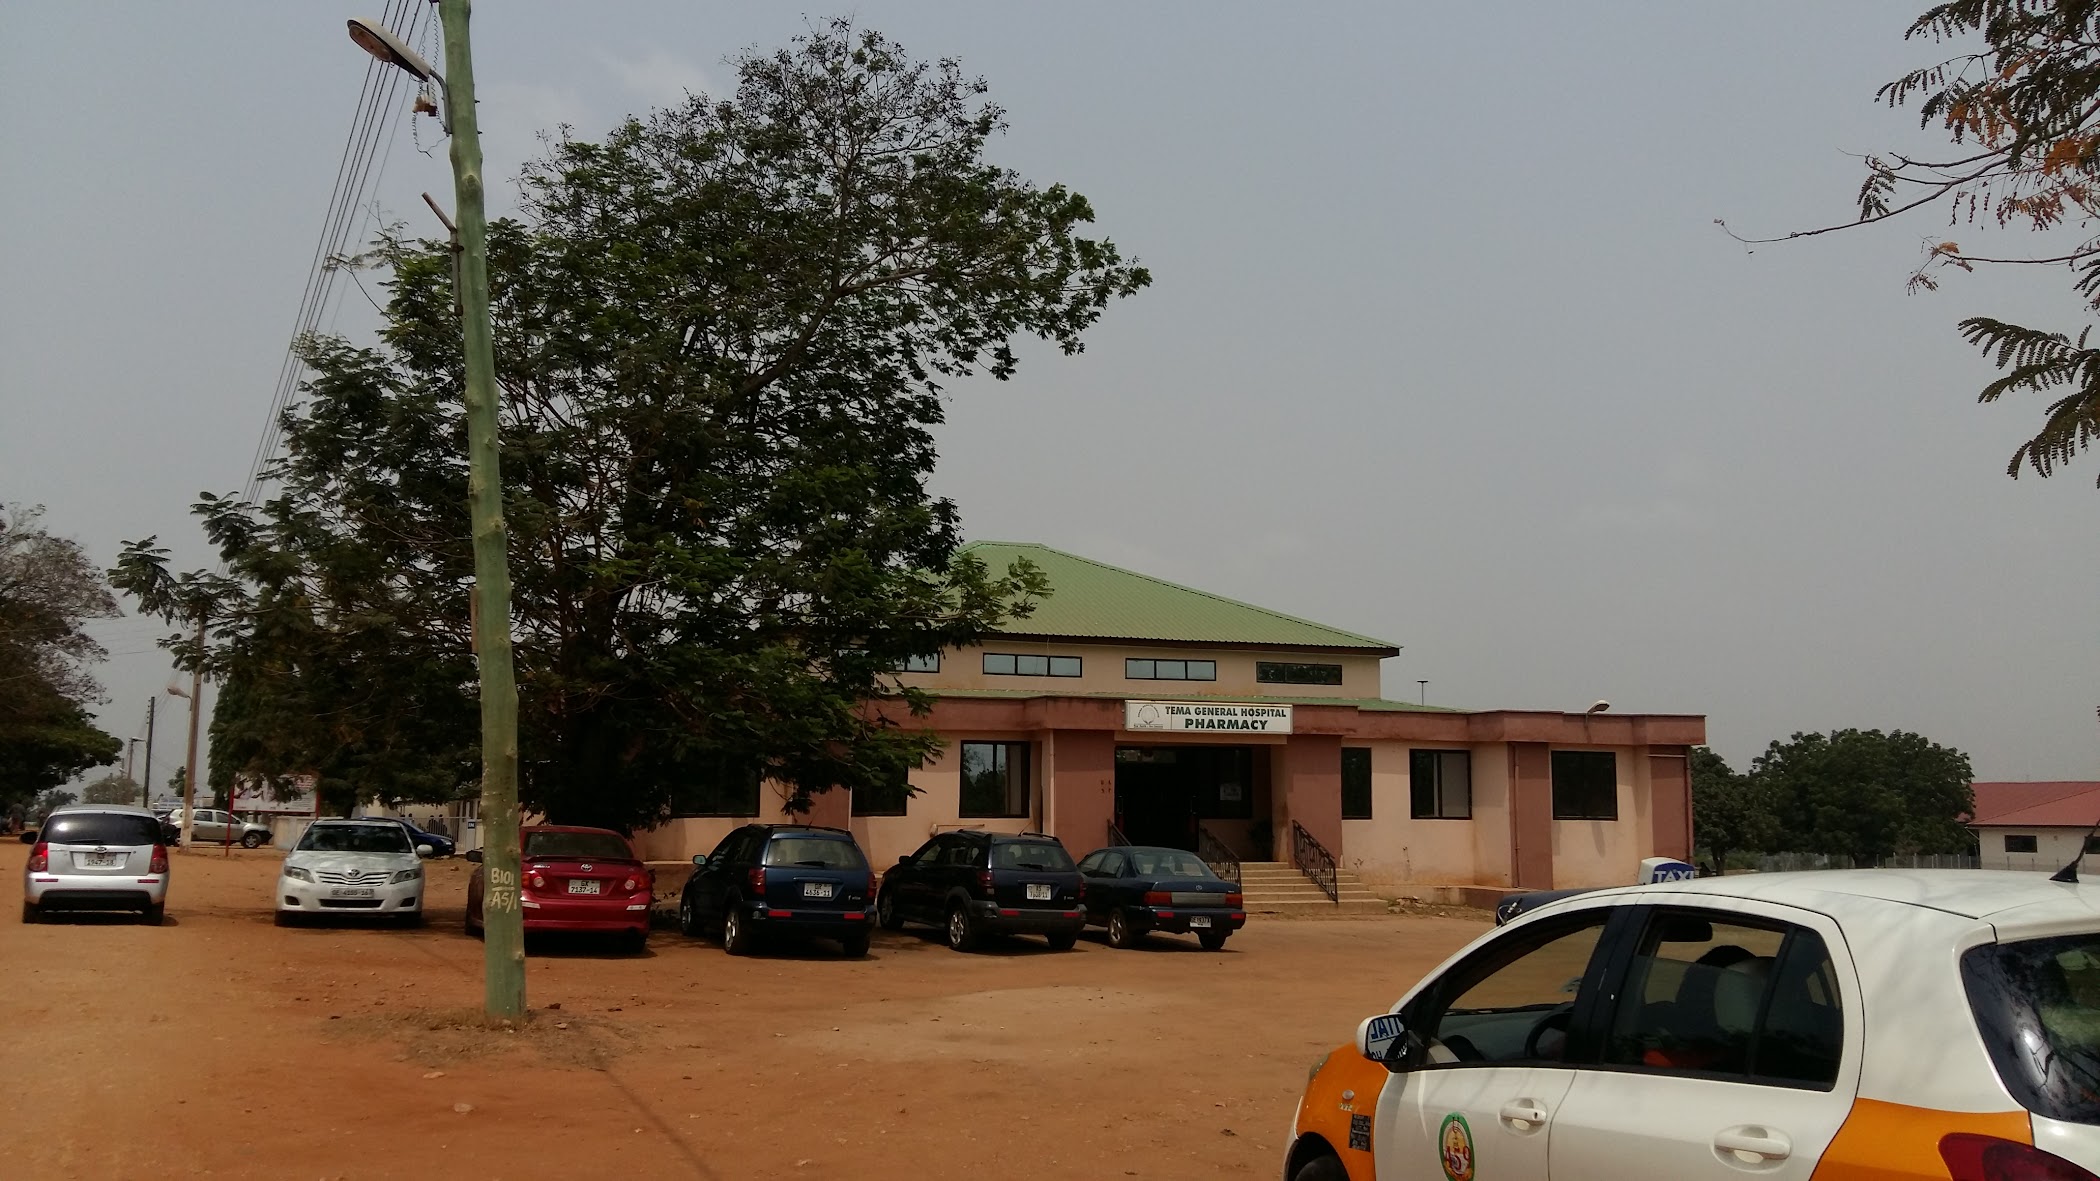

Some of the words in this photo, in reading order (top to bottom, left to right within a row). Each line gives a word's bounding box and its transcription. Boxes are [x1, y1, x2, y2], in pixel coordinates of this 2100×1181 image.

[1165, 706, 1192, 715] TEMA
[1194, 707, 1238, 717] GENERAL
[1241, 708, 1287, 718] HOSPITAL
[1184, 718, 1268, 730] PHARMACY
[1654, 868, 1695, 883] TAXI
[570, 886, 598, 894] 7137-14
